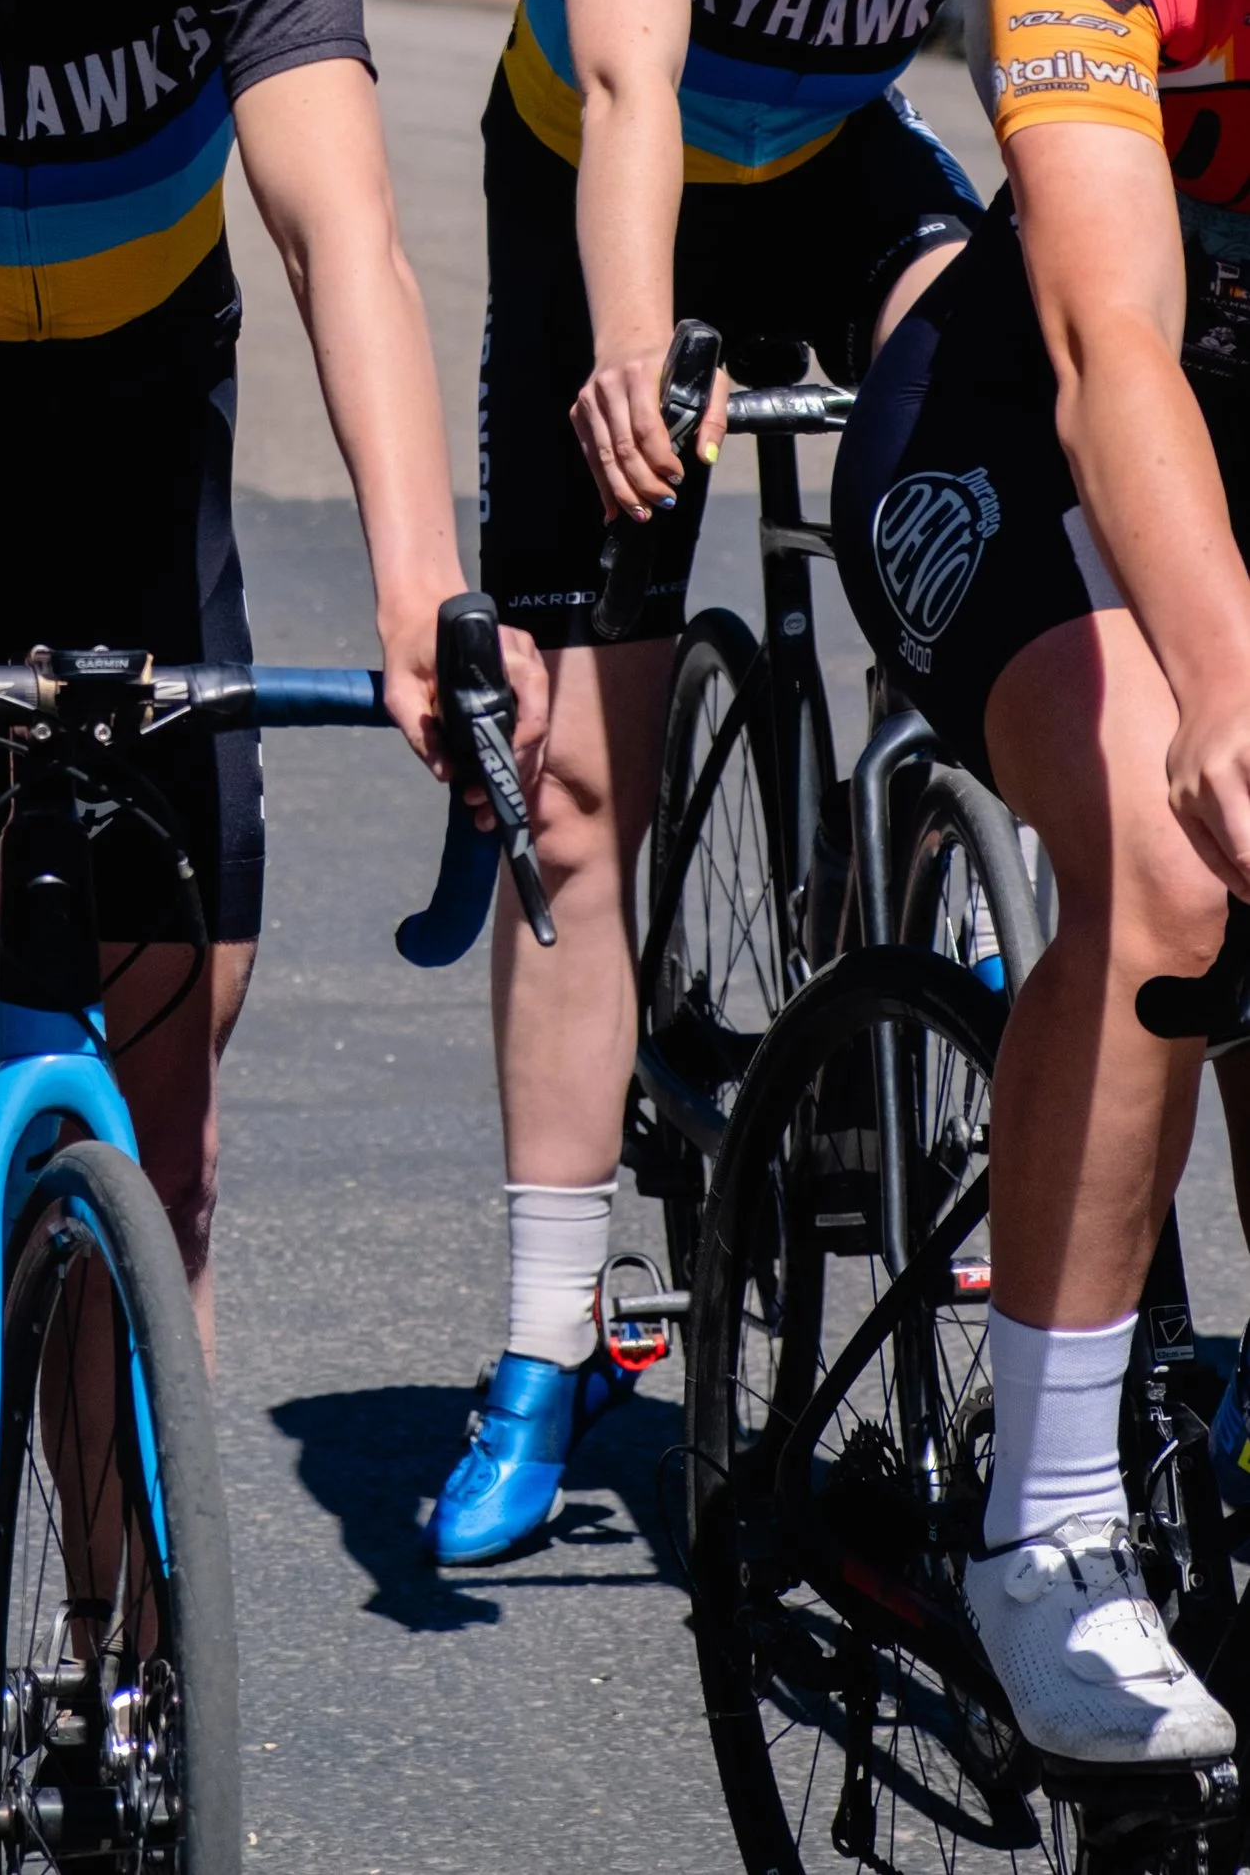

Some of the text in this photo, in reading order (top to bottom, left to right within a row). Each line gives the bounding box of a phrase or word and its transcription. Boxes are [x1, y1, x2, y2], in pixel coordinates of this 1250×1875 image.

[1009, 11, 1131, 37] VOLER
[955, 466, 1002, 540] Durango
[881, 484, 973, 629] DEVO
[75, 658, 130, 669] GARMIN
[899, 630, 932, 674] 3000
